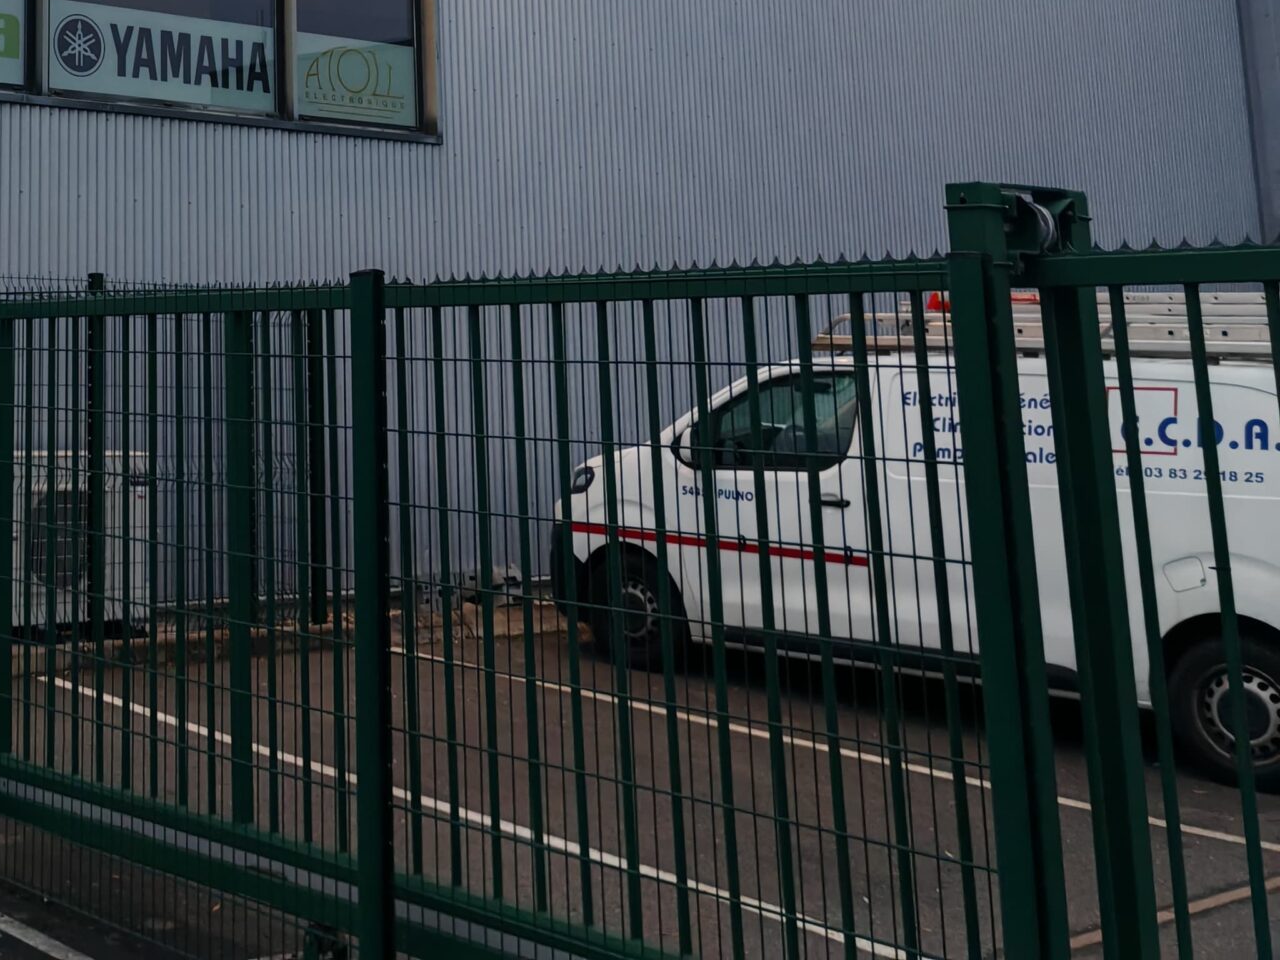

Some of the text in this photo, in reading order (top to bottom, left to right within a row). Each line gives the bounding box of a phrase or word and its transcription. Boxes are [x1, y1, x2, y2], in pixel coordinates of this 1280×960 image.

[109, 22, 271, 94] YAMAHA
[1144, 466, 1163, 478] 03
[1168, 468, 1187, 479] 83
[1244, 471, 1264, 483] 25
